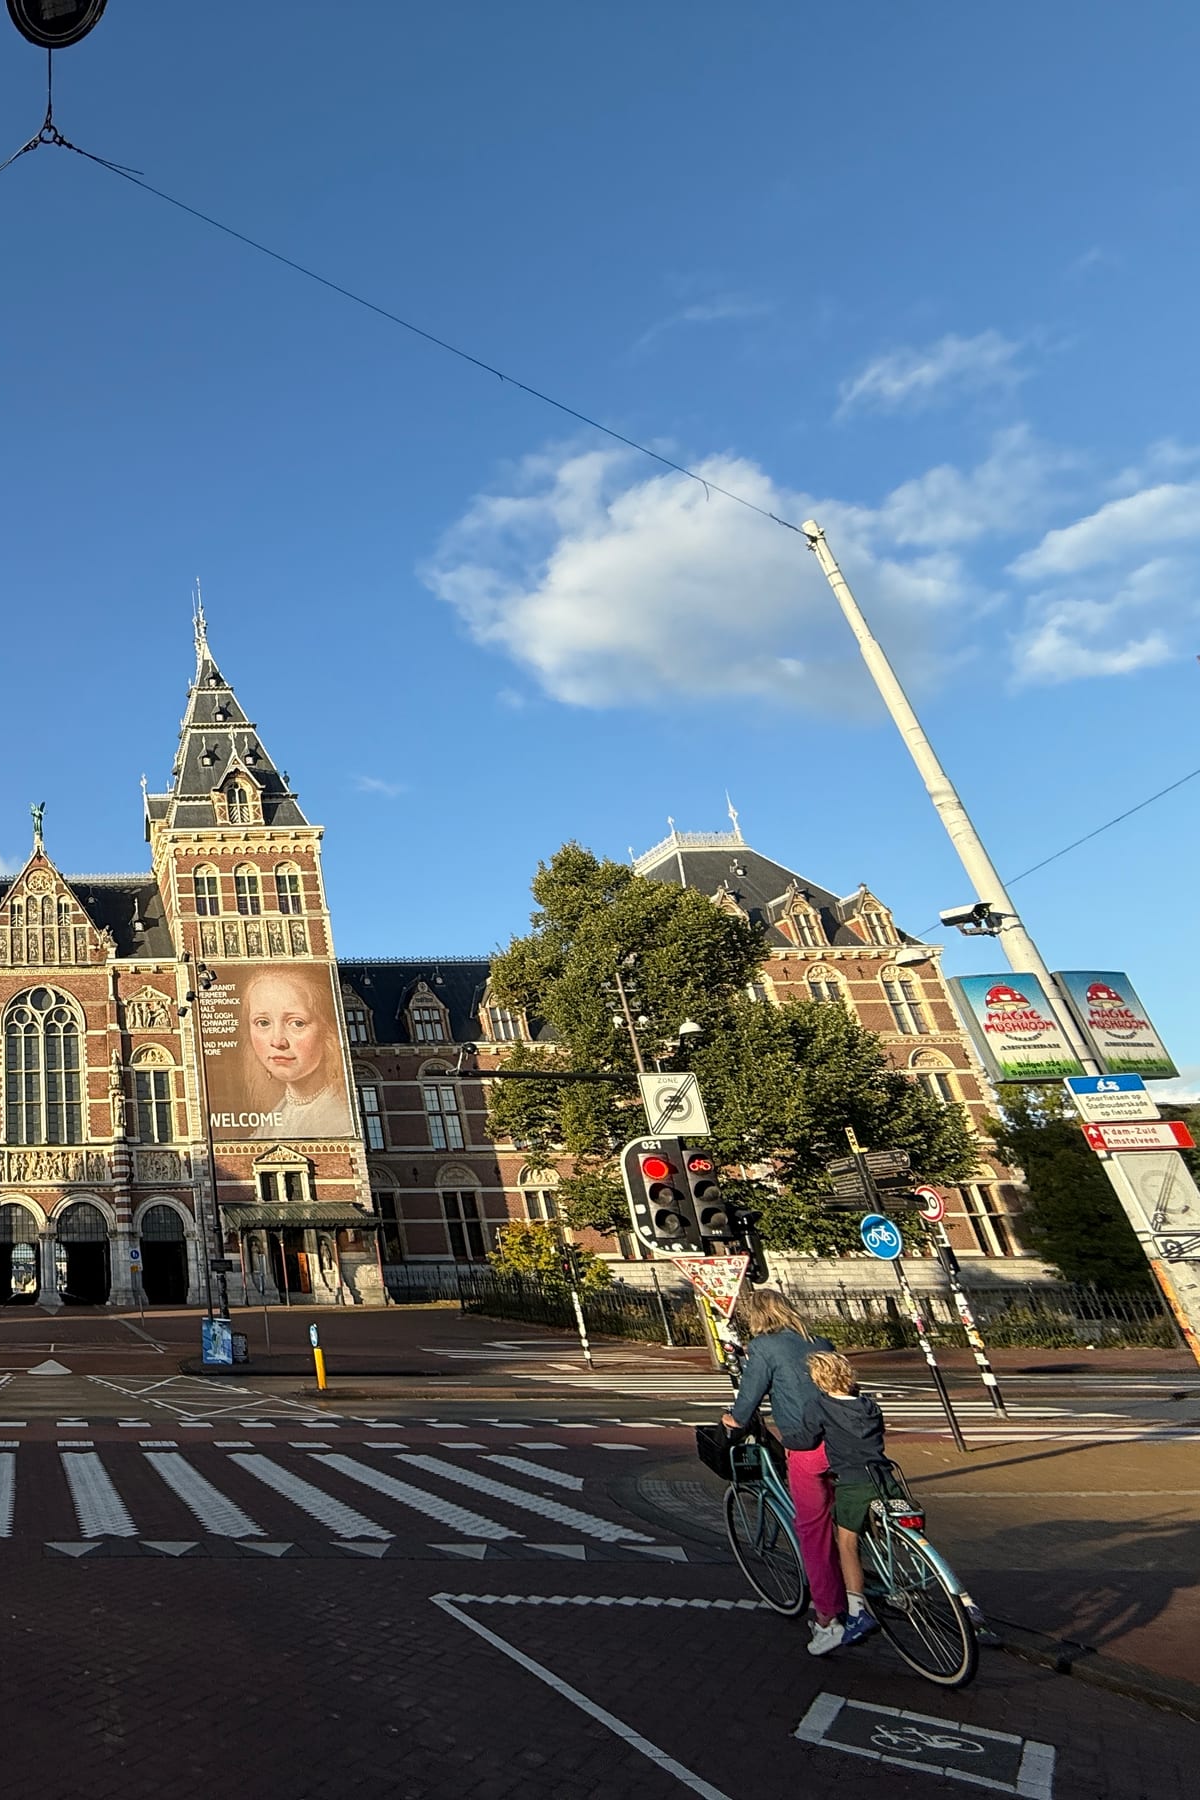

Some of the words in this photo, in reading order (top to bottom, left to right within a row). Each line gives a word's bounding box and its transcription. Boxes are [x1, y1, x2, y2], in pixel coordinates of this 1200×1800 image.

[987, 1010, 1042, 1021] MAGIC
[1088, 1009, 1135, 1019] MAGIC
[984, 1021, 1057, 1033] MUSHROOM
[1088, 1020, 1150, 1030] MUSHROOM
[210, 1112, 283, 1128] WELCOME
[1103, 1127, 1157, 1135] A'dam-Zuid
[641, 1141, 661, 1150] 021
[1107, 1137, 1160, 1145] Amstelveen
